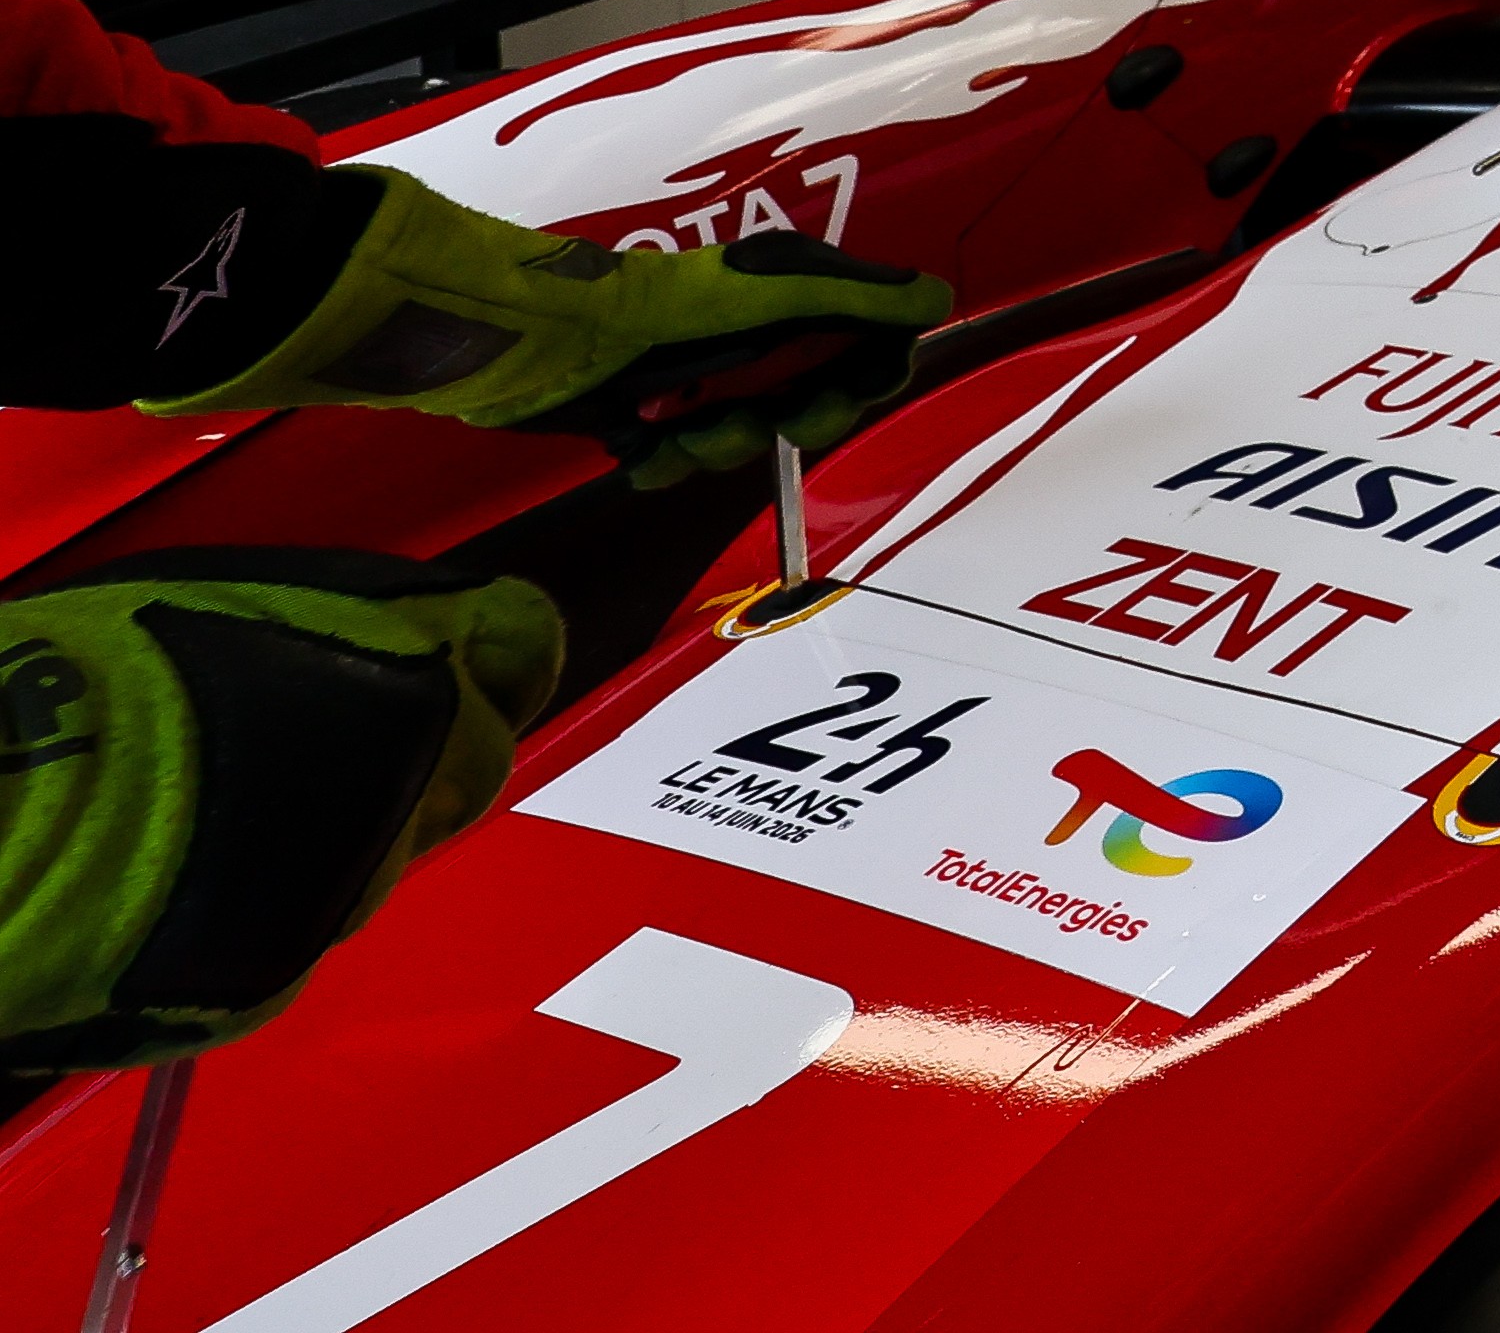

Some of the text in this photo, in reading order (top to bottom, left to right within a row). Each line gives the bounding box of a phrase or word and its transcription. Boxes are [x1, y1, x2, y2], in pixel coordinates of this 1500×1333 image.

[1017, 537, 1413, 680] ZENT
[659, 760, 739, 792] LE
[650, 793, 817, 845] 10 AU 14 JUIN 2026
[922, 847, 1151, 944] TotalEnergies
